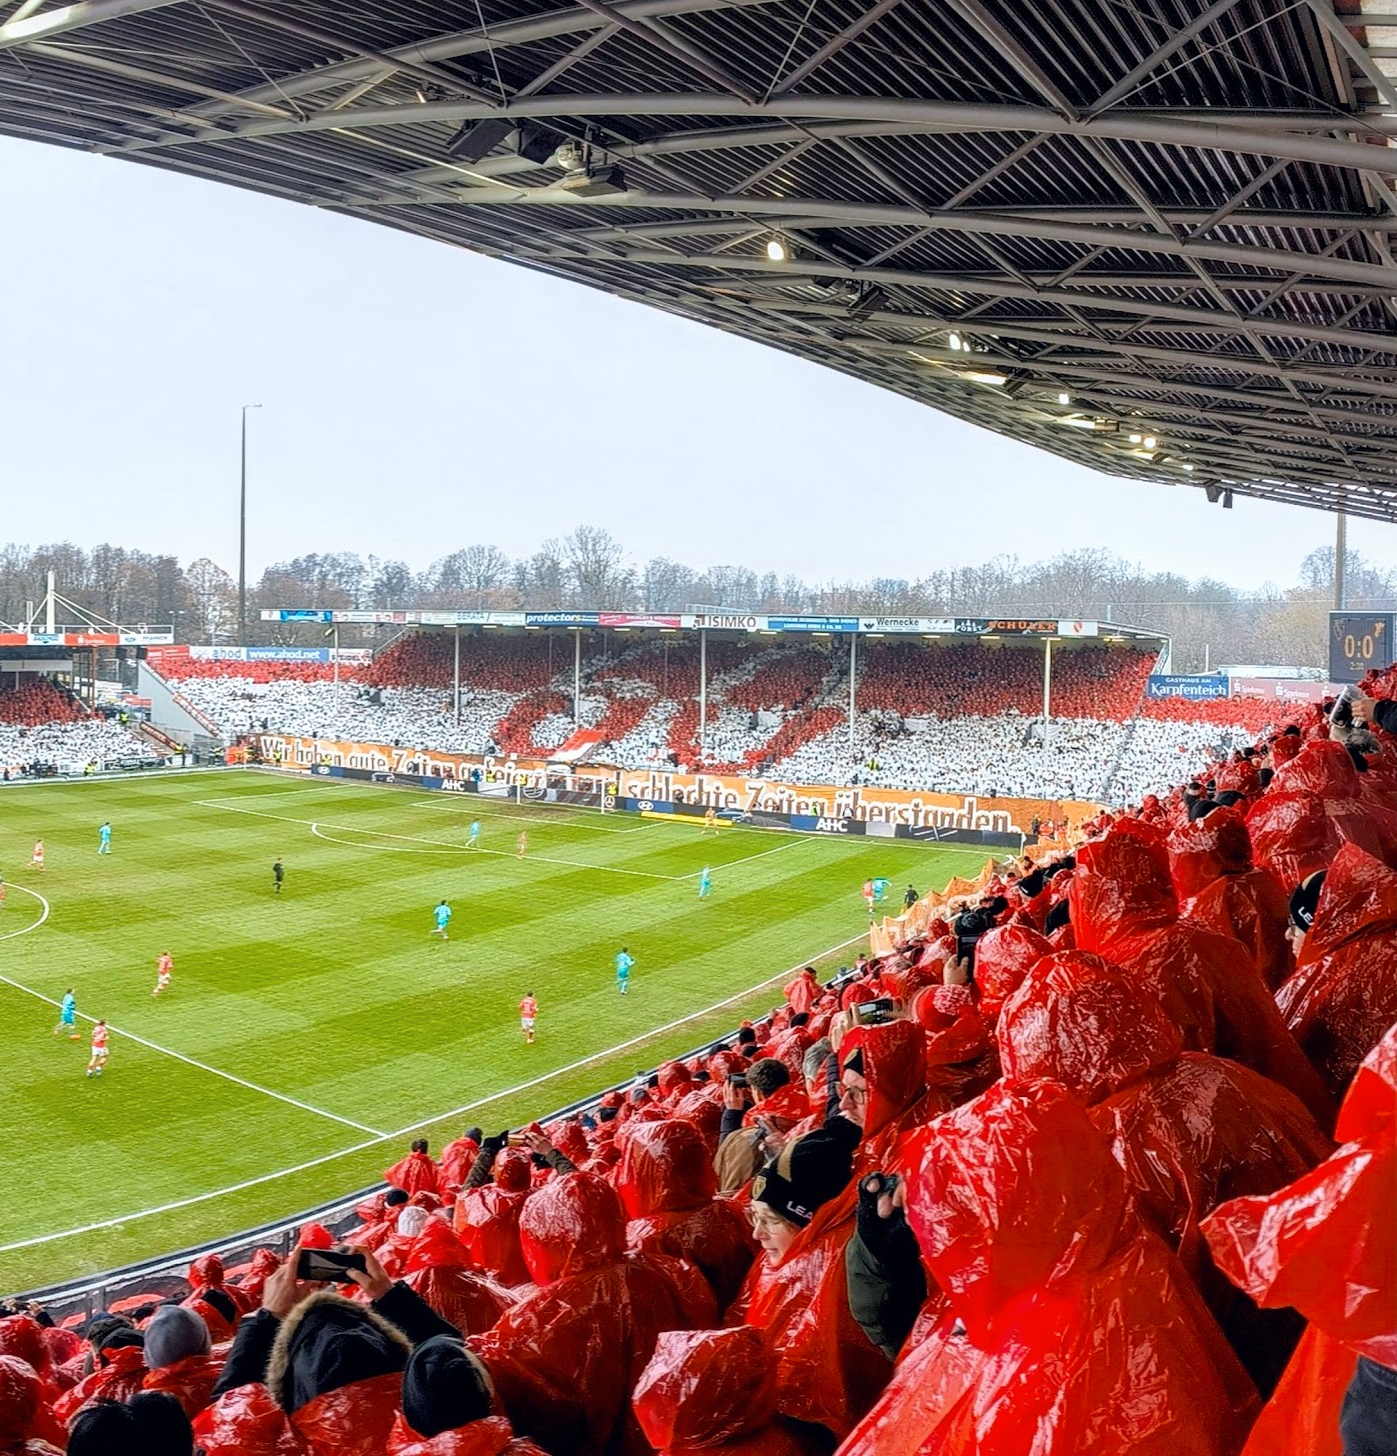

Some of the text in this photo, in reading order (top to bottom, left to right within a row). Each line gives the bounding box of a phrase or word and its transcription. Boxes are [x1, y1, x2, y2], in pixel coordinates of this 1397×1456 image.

[526, 612, 582, 624] protectors
[707, 615, 756, 628] ISIMKO
[876, 618, 919, 626] Wernecke
[212, 647, 242, 659] ahod
[1344, 634, 1374, 659] 0:0
[249, 648, 321, 660] www.ahod.net
[1151, 682, 1227, 697] Karpfenteich
[260, 735, 292, 762] Wir
[441, 779, 466, 791] AHC
[626, 771, 741, 812] schlechte
[815, 817, 849, 833] AHC
[786, 1200, 813, 1220] LEA
